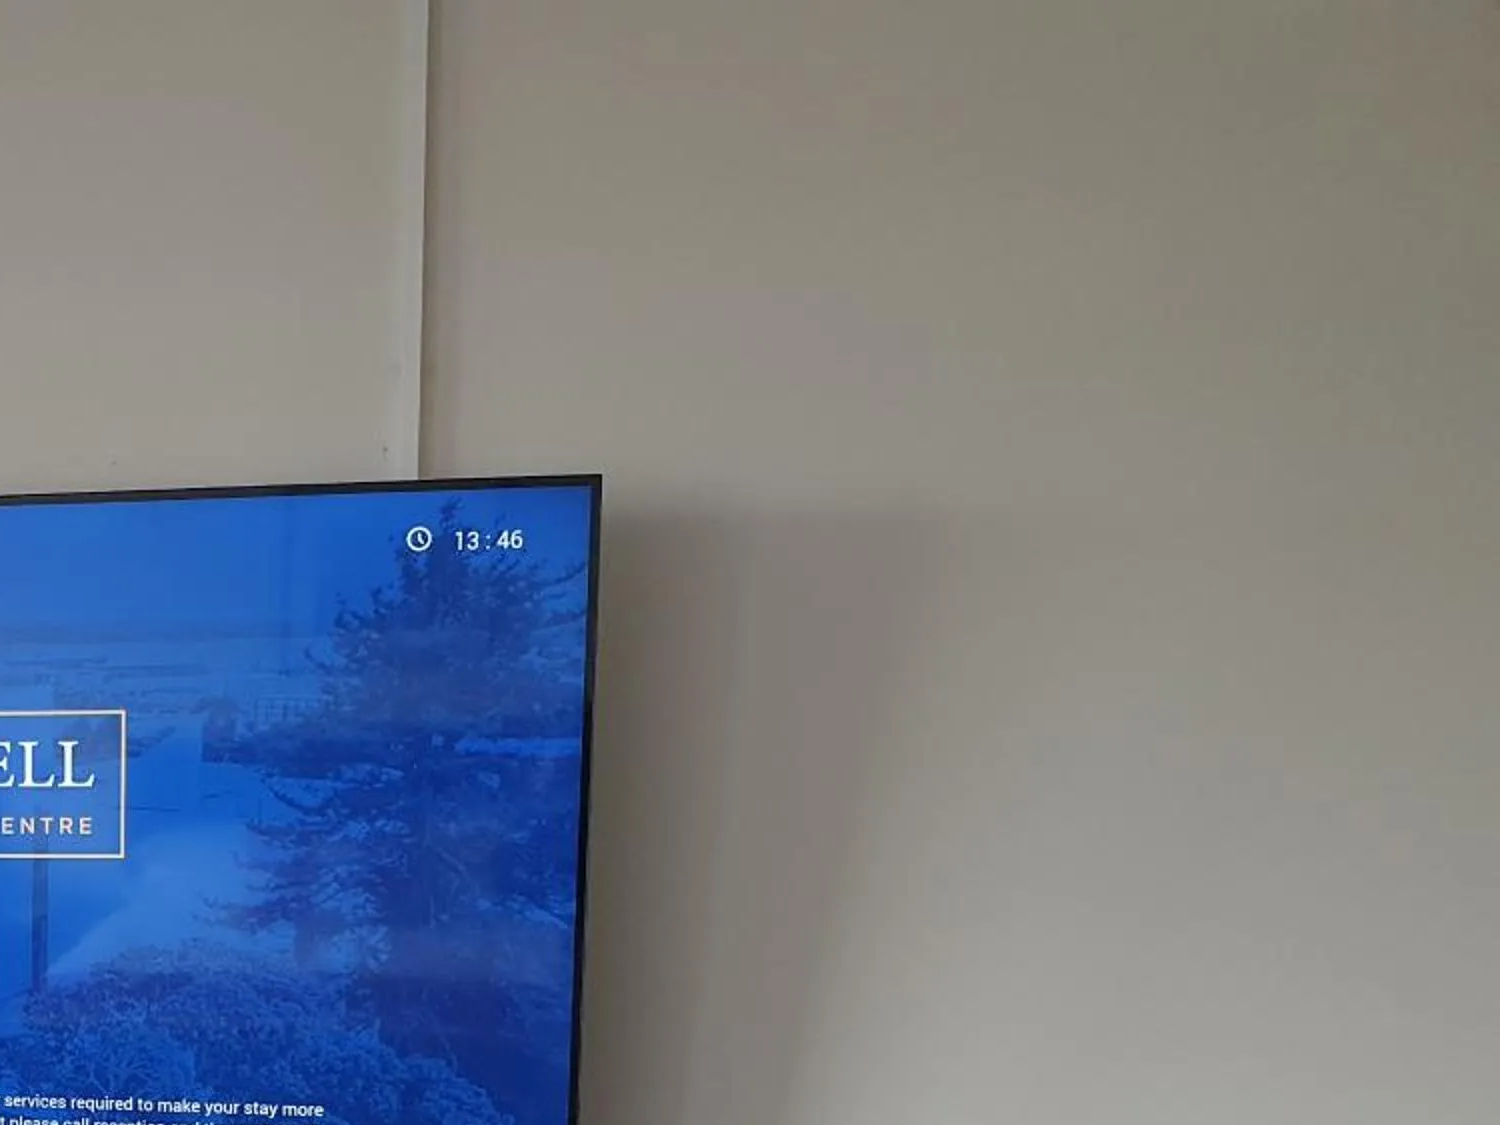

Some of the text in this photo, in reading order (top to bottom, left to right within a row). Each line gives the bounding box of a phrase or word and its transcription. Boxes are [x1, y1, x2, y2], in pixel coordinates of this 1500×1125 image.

[4, 1094, 67, 1109] services
[70, 1096, 133, 1112] required
[137, 1098, 153, 1111] to
[157, 1099, 200, 1113] make
[204, 1103, 240, 1117] your
[244, 1103, 277, 1118] stay
[282, 1105, 325, 1117] more
